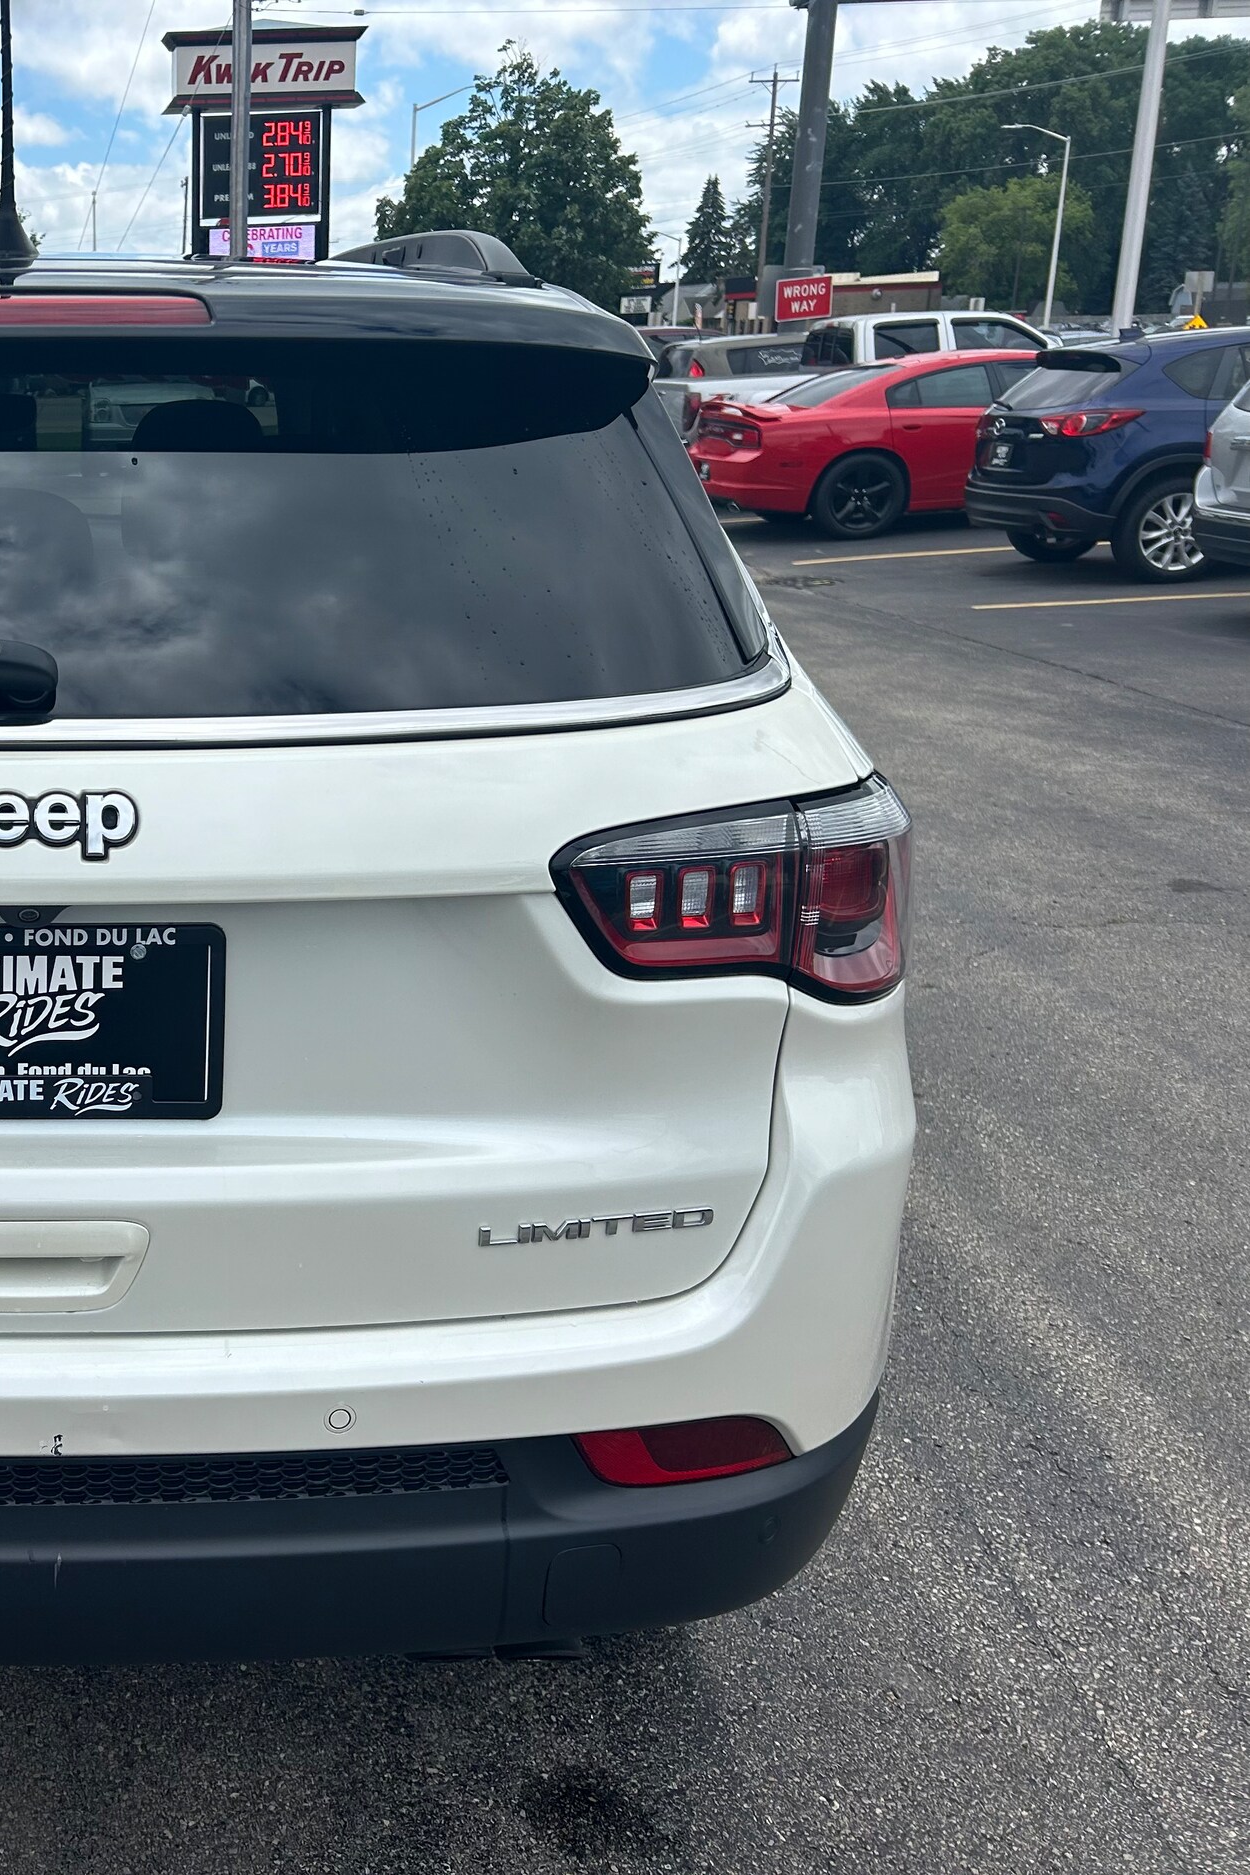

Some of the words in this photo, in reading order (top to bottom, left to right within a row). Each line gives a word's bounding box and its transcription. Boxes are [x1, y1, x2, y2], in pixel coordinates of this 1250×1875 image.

[187, 55, 275, 85] KWK
[278, 52, 345, 83] TRIP
[214, 131, 255, 140] UNLD
[262, 121, 303, 147] 2.84
[262, 152, 302, 177] 2.70
[213, 193, 255, 202] PREM
[263, 183, 302, 208] 3.84
[222, 226, 303, 242] CBRATING
[263, 242, 298, 254] YEARS
[783, 283, 826, 299] WRONG
[791, 299, 817, 313] WAY
[24, 929, 88, 946] FOND
[96, 928, 131, 945] DU
[136, 927, 176, 946] LAC
[479, 1206, 714, 1247] LIMITED
